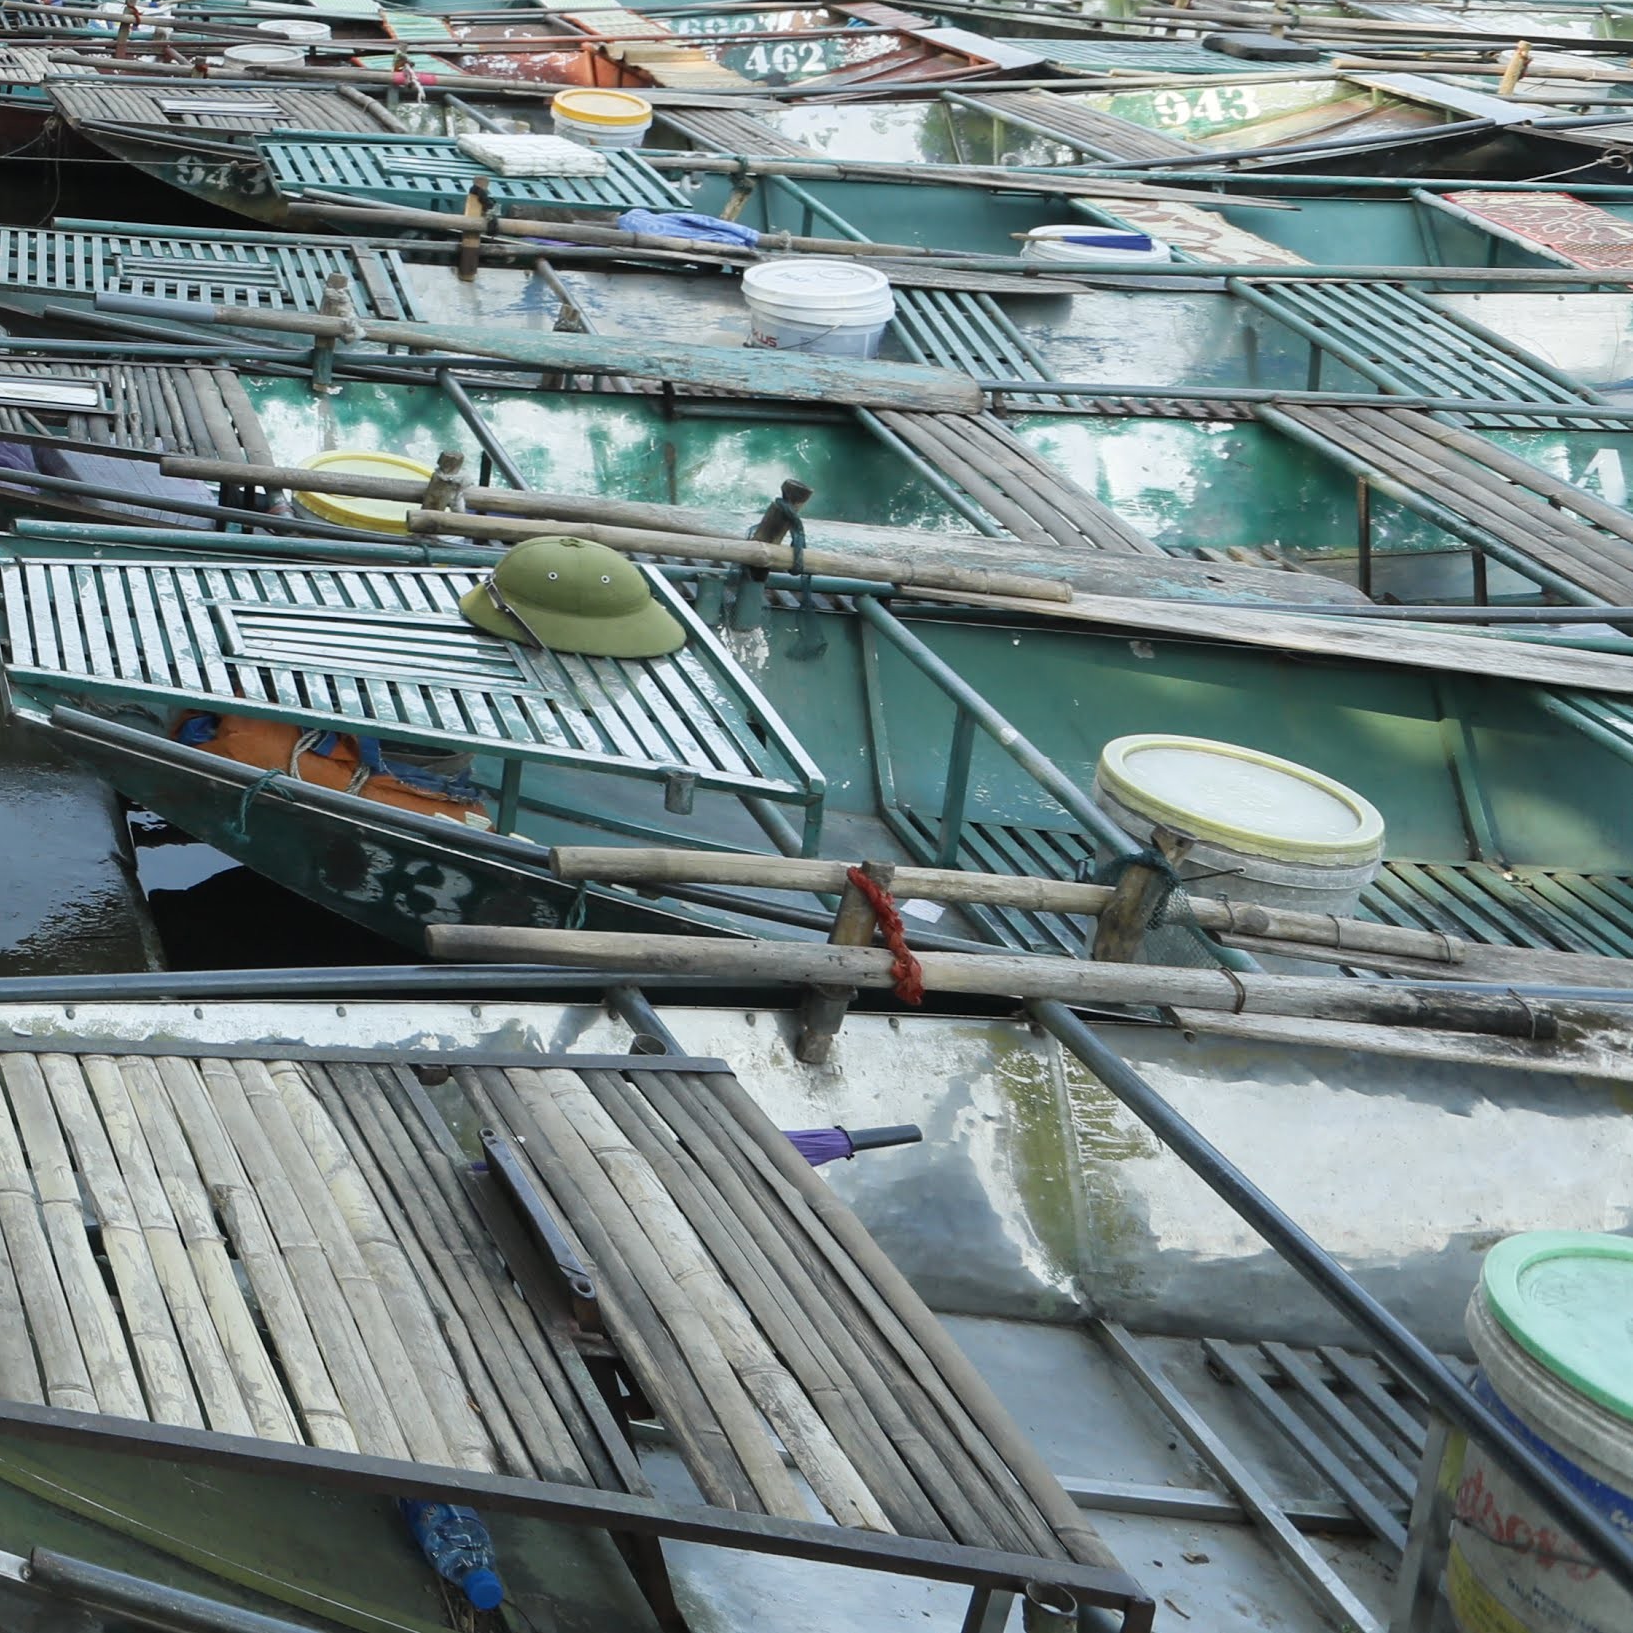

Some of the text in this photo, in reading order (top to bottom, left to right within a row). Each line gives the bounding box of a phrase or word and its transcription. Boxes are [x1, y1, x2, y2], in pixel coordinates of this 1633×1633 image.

[744, 41, 827, 75] 462
[1153, 84, 1263, 126] 943
[176, 154, 267, 196] 943
